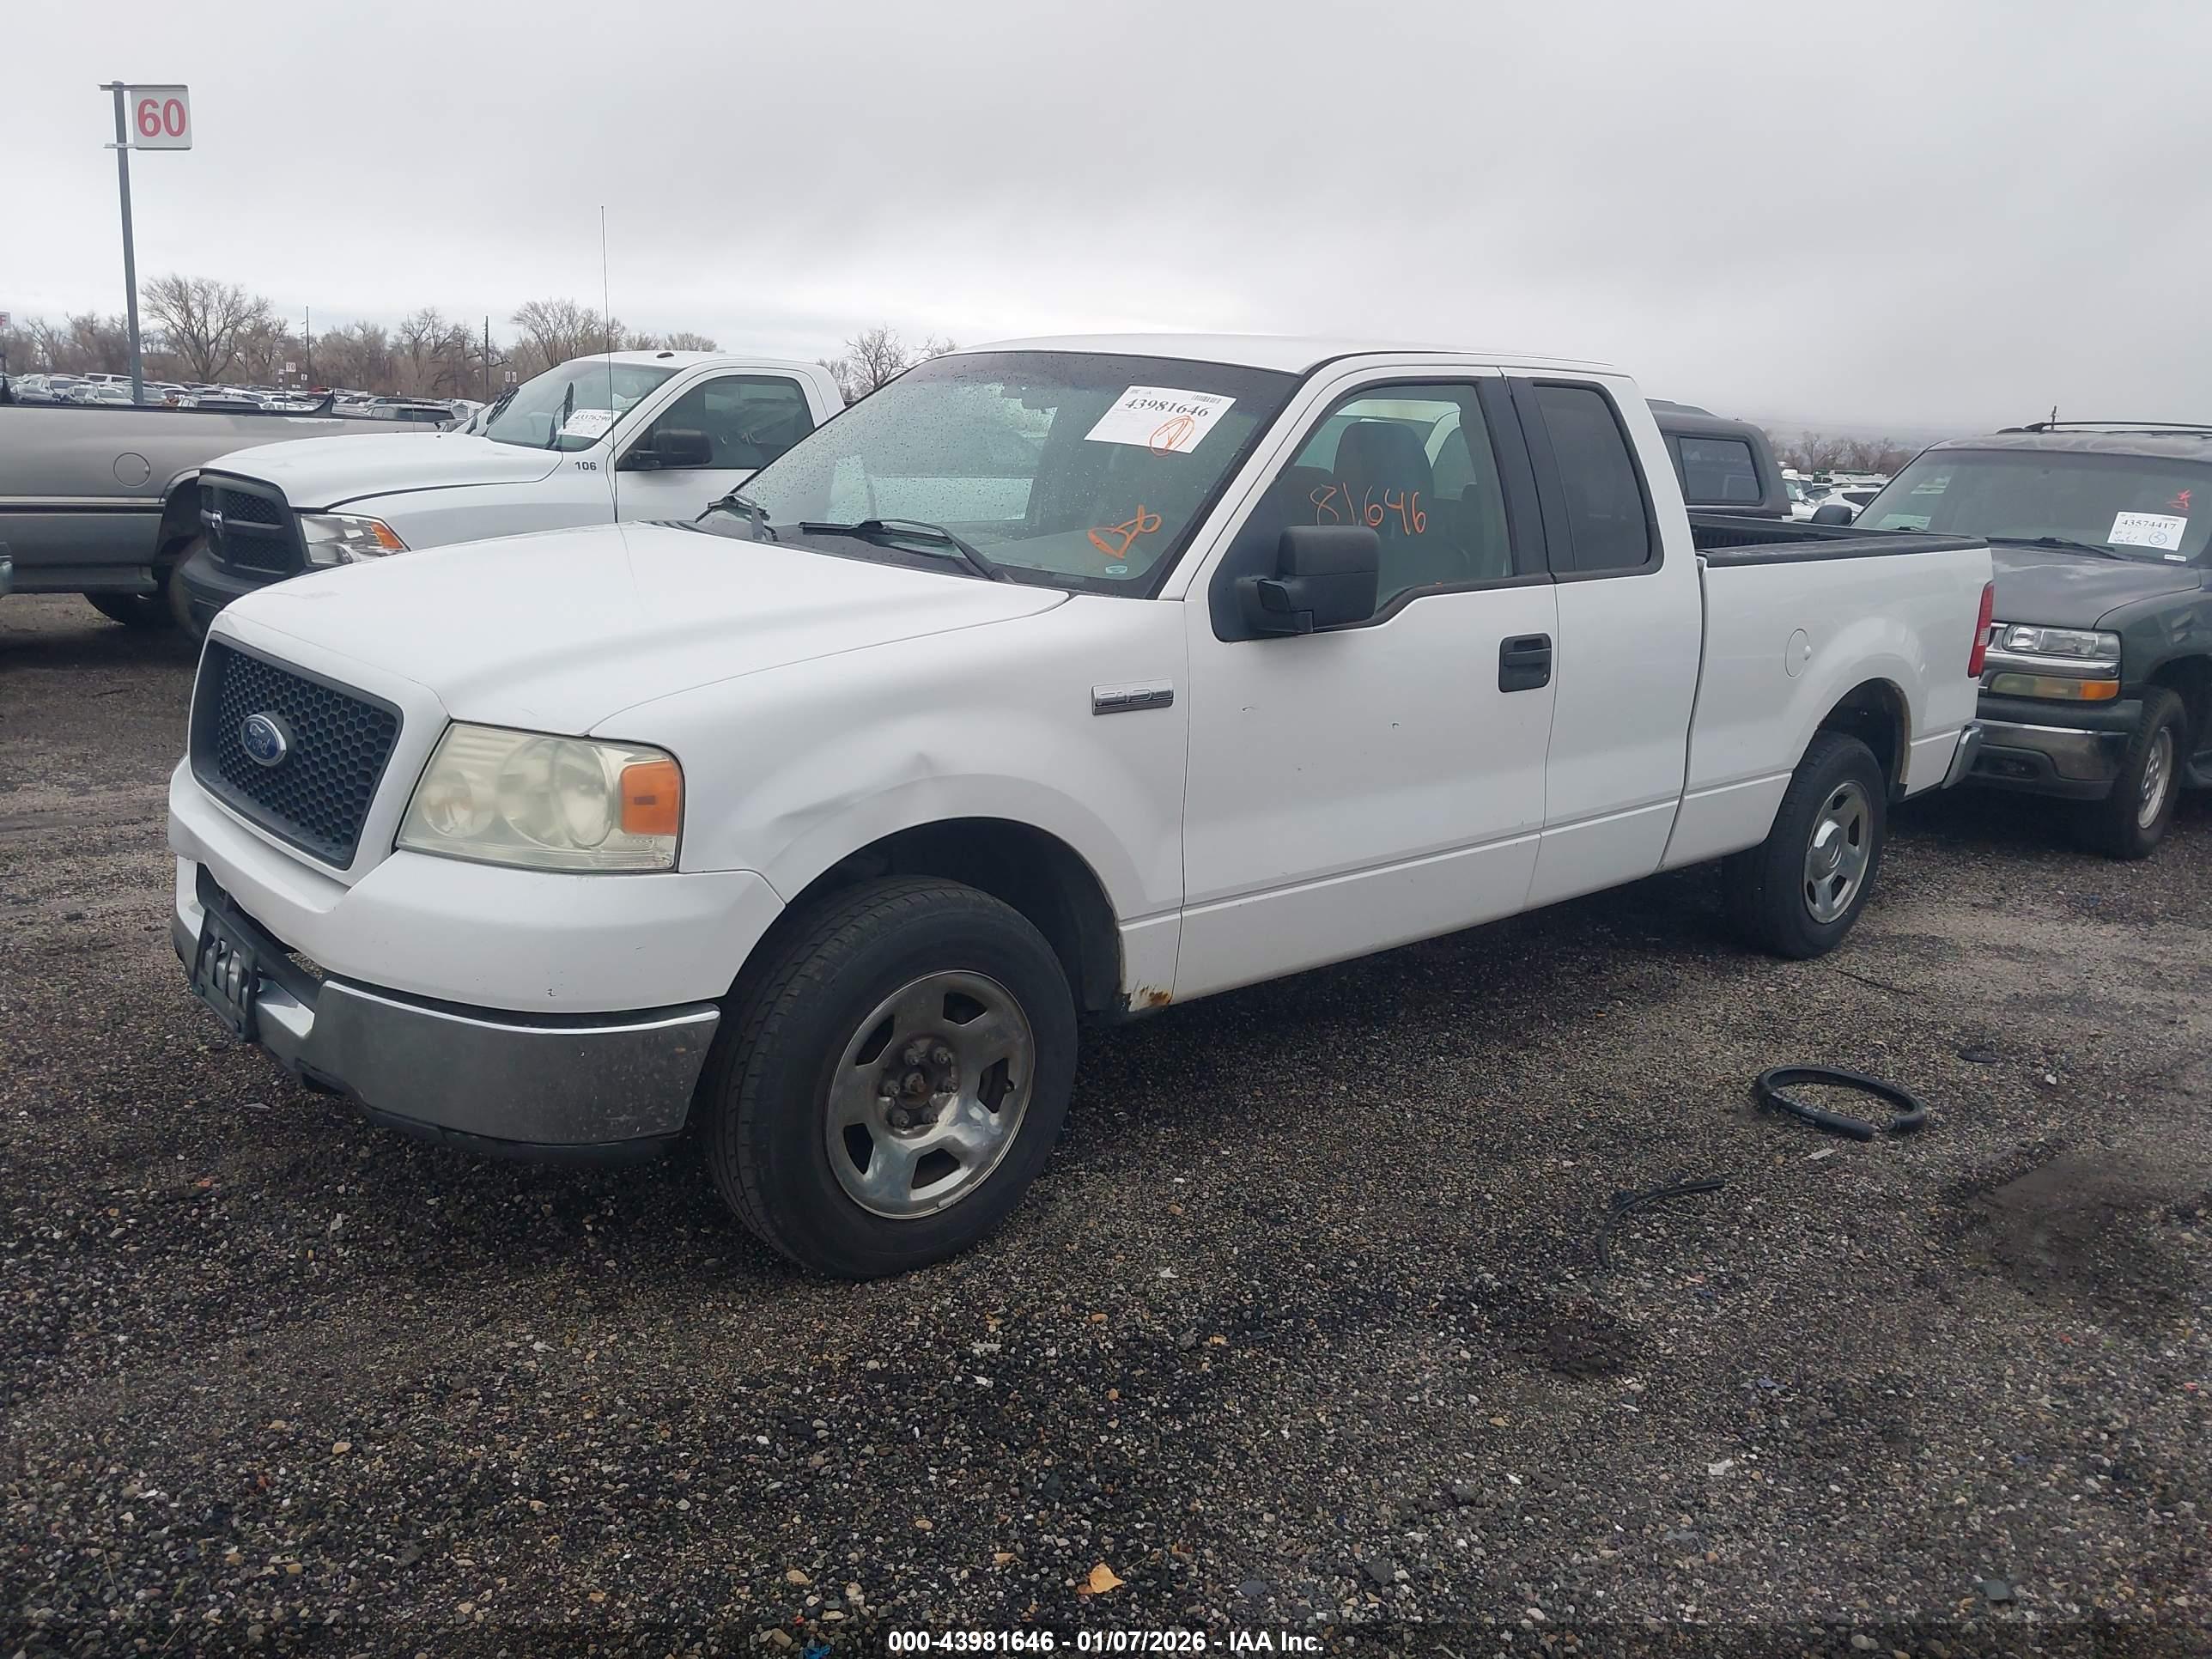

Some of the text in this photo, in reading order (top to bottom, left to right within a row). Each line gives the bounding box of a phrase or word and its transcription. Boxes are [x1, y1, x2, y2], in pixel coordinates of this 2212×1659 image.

[137, 98, 186, 137] 60
[1124, 398, 1211, 418] 43981646
[574, 461, 597, 471] 106
[1309, 481, 1426, 537] 81646
[2121, 519, 2178, 530] 43574417
